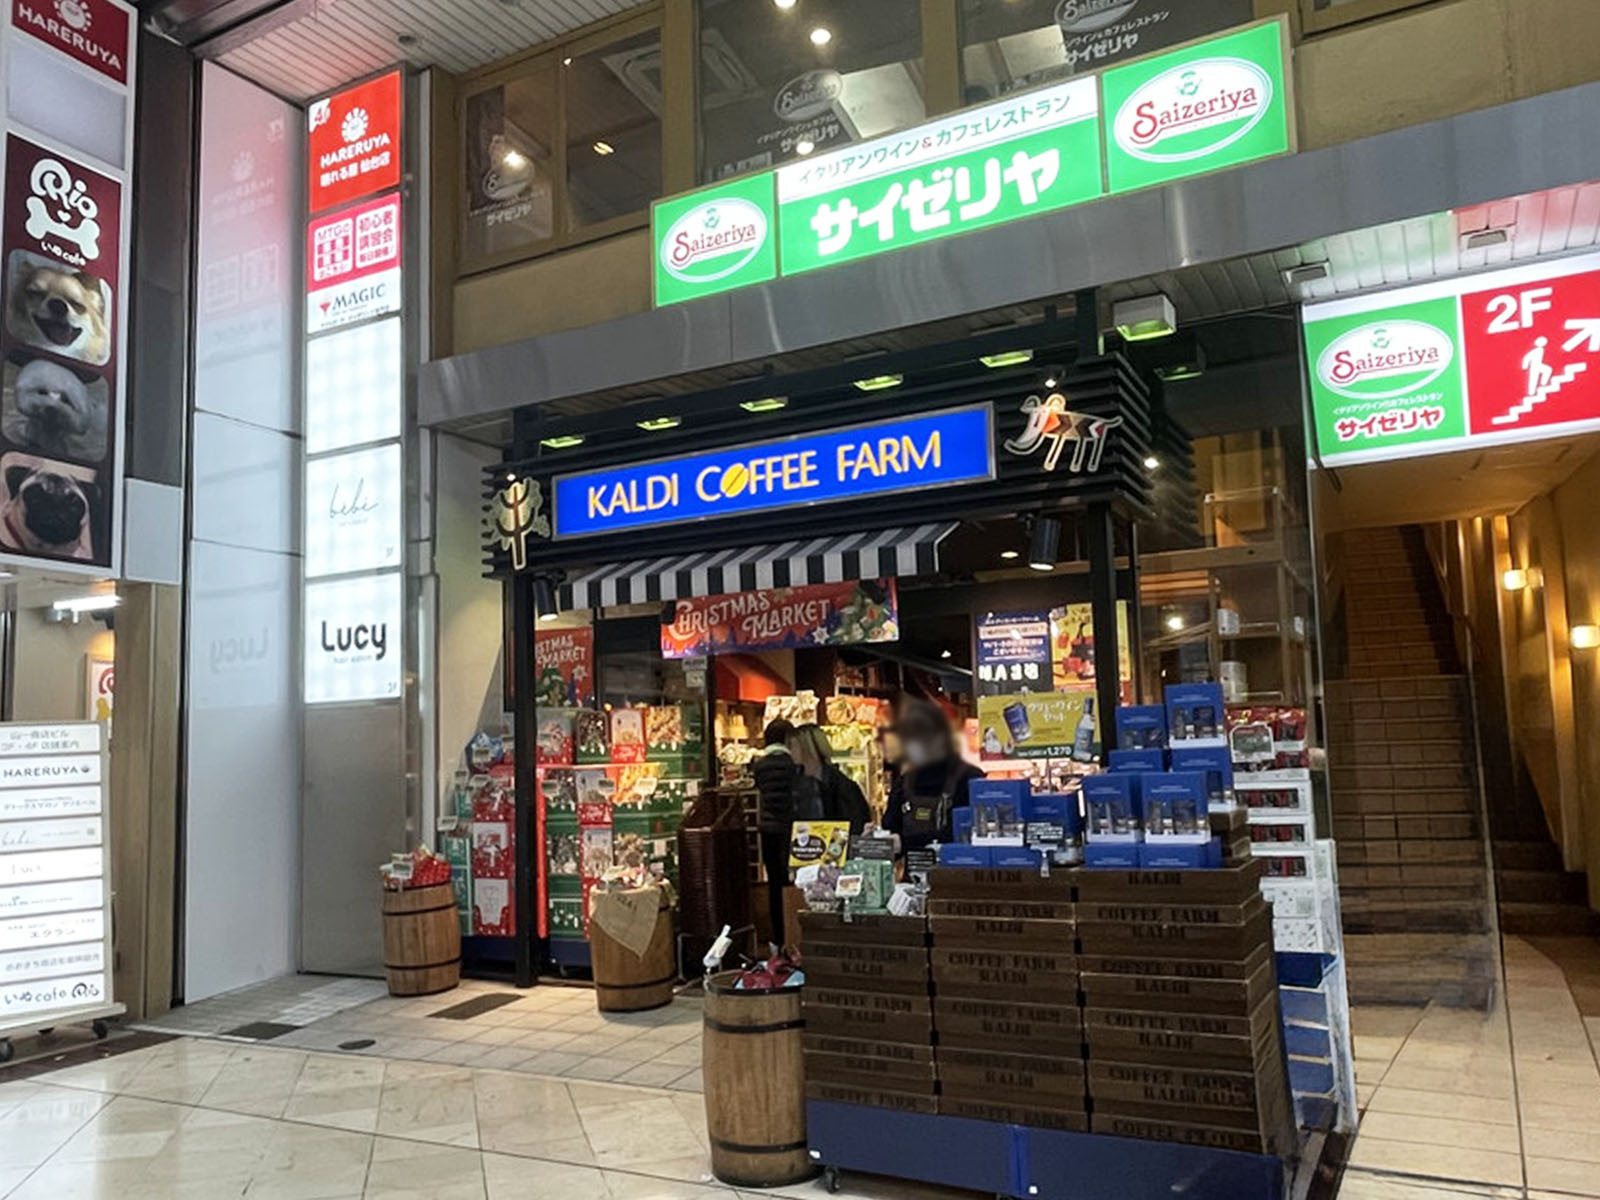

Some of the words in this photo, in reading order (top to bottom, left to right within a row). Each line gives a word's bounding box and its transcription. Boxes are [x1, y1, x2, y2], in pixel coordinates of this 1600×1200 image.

[19, 3, 121, 70] HARERUYA
[1132, 87, 1257, 140] Saizeriya
[320, 133, 390, 169] HARERUYA
[30, 158, 98, 219] Rio
[811, 148, 1060, 257] サイゼリヤ
[673, 222, 756, 263] Saizeriya
[332, 283, 386, 310] MAGIC
[1486, 287, 1553, 334] 2F
[1330, 346, 1439, 383] Saizeriya
[1337, 407, 1442, 439] サイゼリヤ
[588, 473, 679, 519] KALDI
[696, 451, 818, 502] COFFEE
[836, 430, 941, 482] FARM
[669, 591, 770, 641] CHRISTMAS
[742, 600, 830, 639] MARKET
[321, 620, 387, 661] Lucy
[3, 765, 78, 778] HARERUYA
